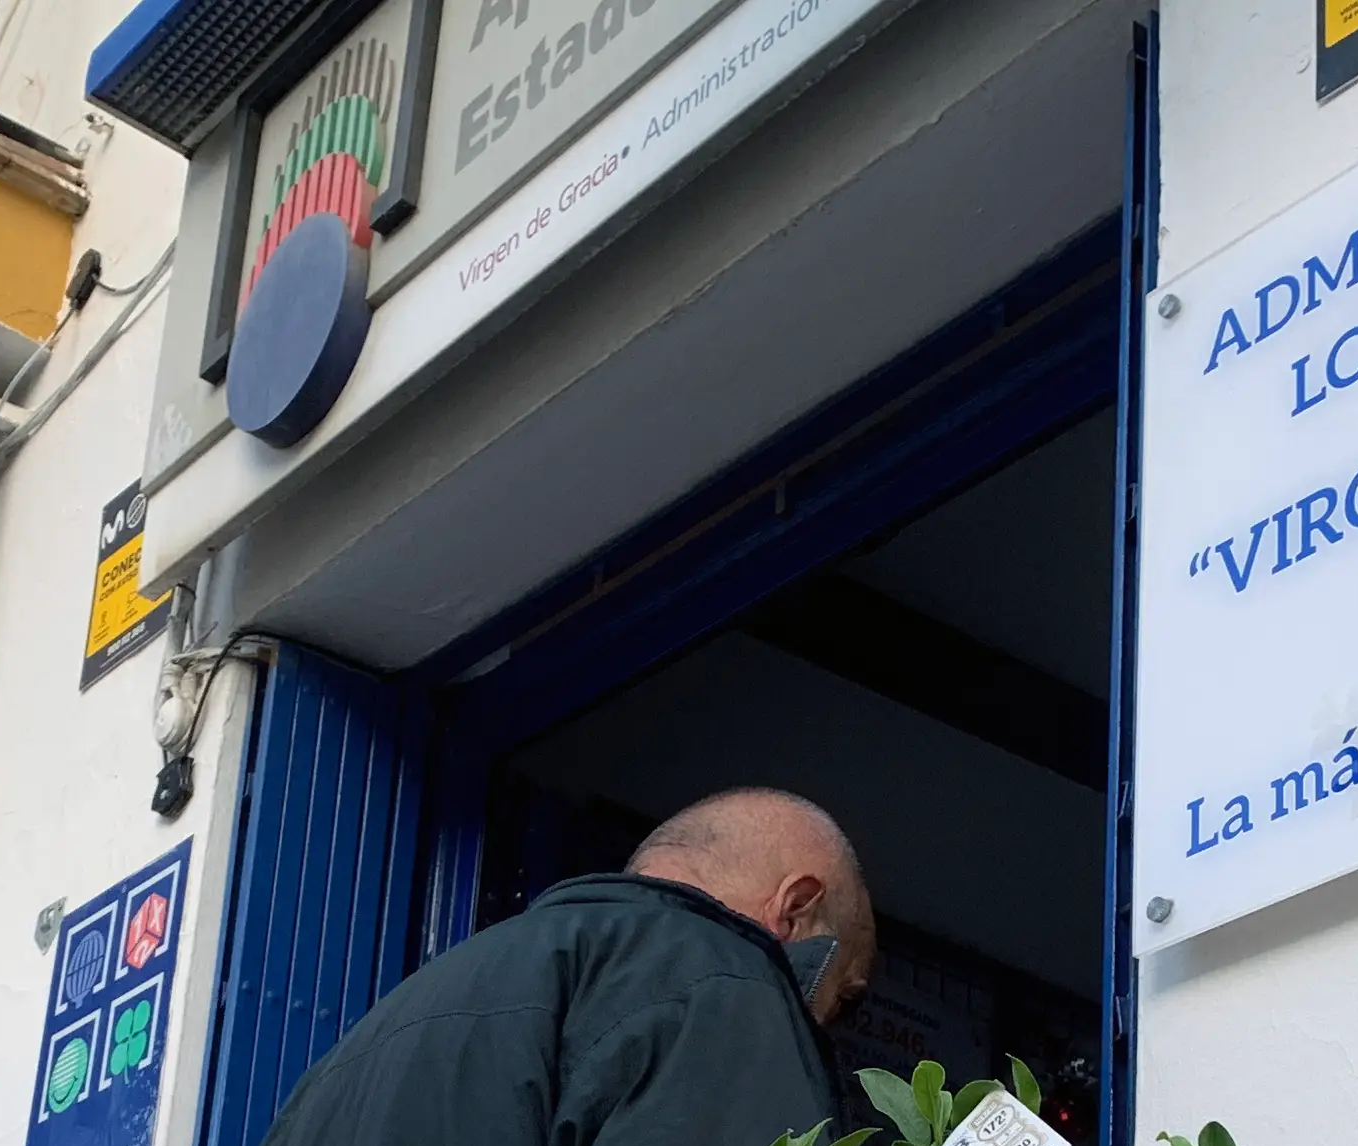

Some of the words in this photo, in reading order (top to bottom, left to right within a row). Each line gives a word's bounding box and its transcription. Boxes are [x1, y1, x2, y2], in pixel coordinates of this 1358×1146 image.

[458, 233, 520, 292] Virgen
[525, 207, 552, 240] de
[558, 152, 619, 212] Gracia
[1186, 795, 1254, 857] La
